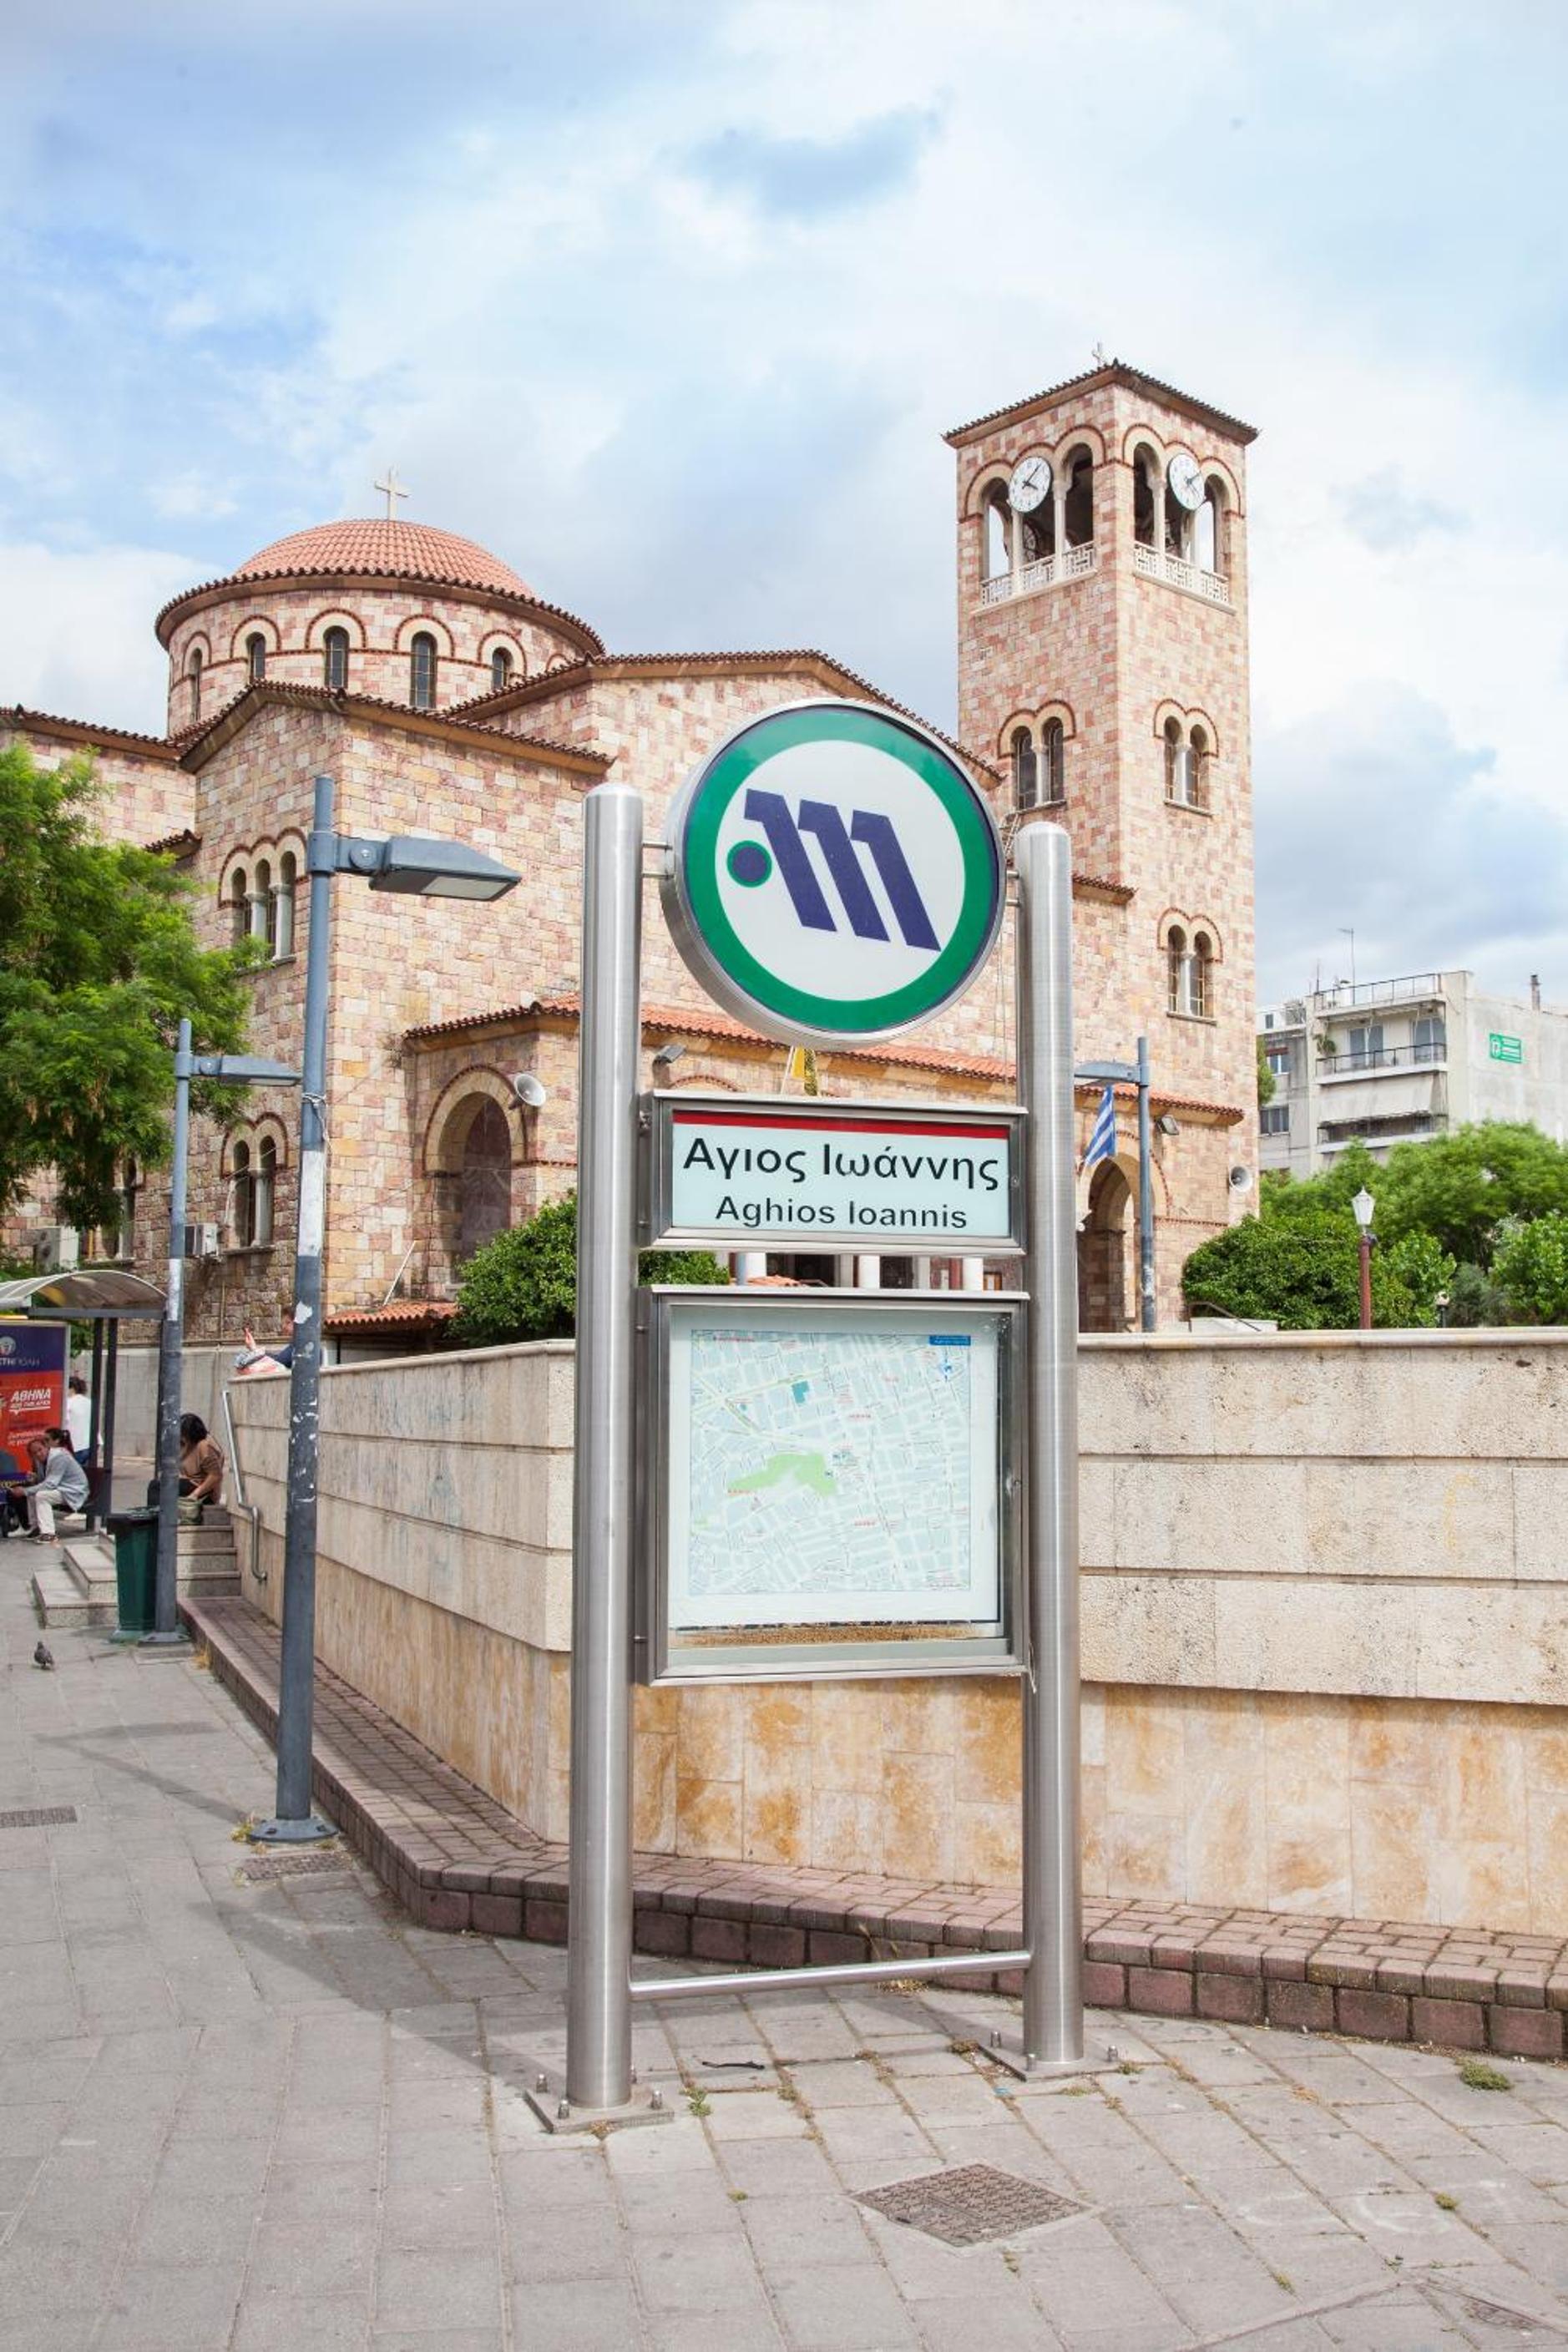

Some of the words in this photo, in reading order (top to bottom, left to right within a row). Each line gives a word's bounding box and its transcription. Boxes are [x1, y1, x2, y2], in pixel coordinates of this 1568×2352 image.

[682, 1137, 807, 1184] Αγιος
[823, 1143, 999, 1191] Ιωάννης
[715, 1196, 836, 1228] Aghios
[849, 1201, 967, 1229] Ioannis
[10, 1388, 52, 1403] ΑΘΗΝΑ
